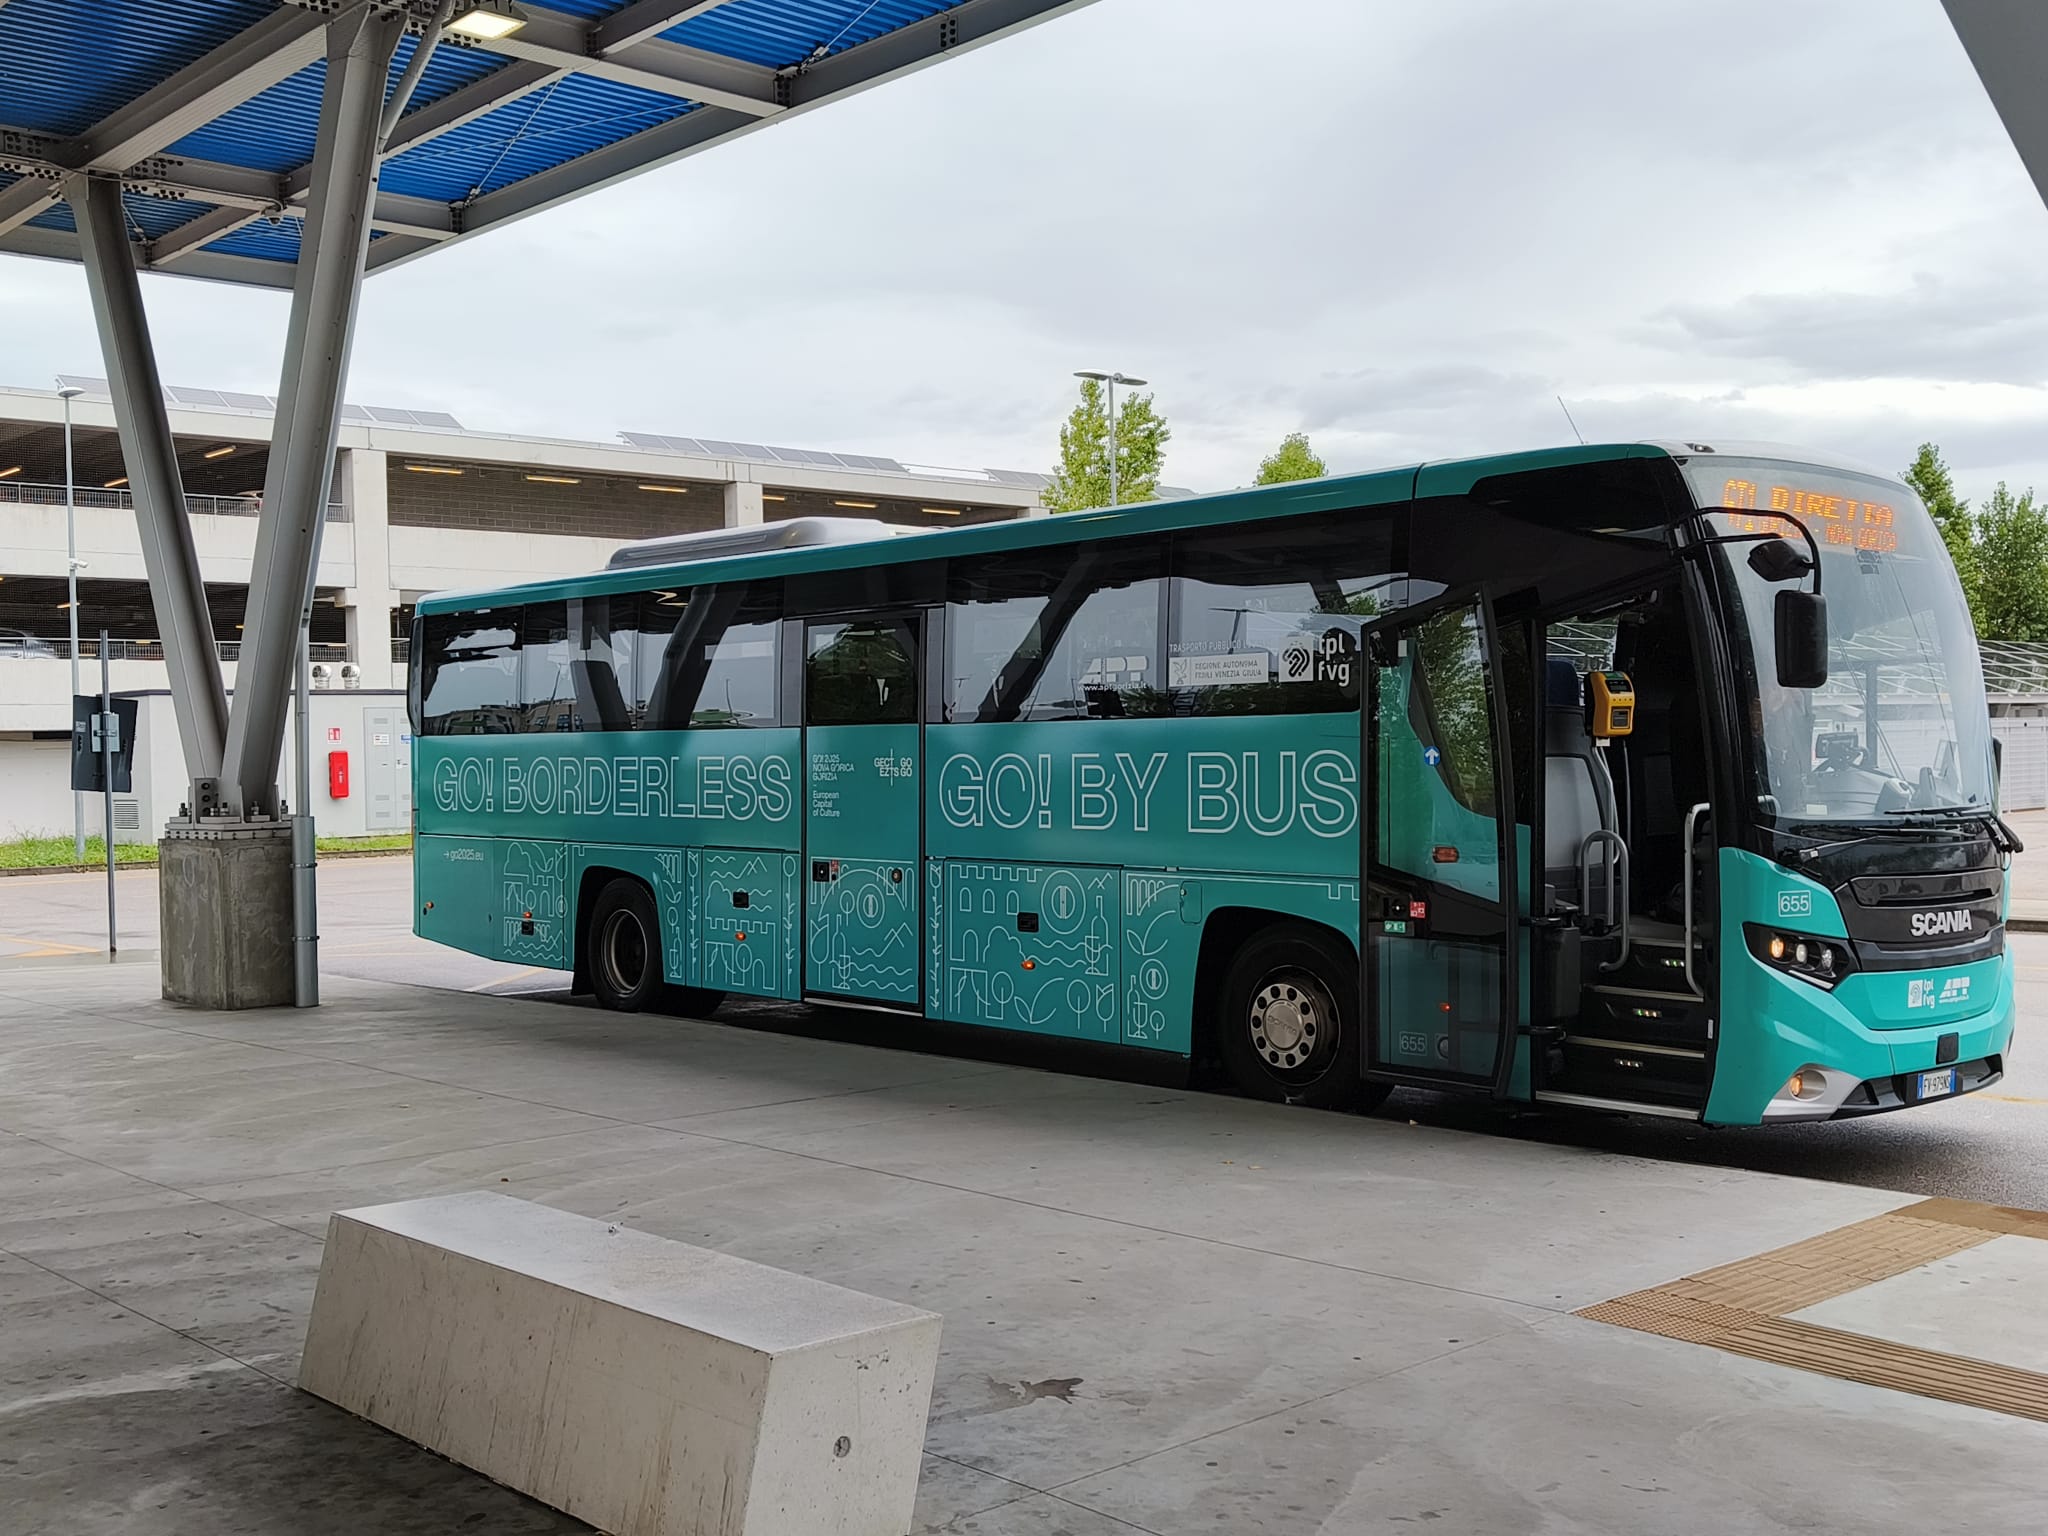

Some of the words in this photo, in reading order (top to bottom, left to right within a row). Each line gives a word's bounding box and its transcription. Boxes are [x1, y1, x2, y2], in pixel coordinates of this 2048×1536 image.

[1771, 486, 1893, 528] DIRETTA
[1318, 660, 1350, 687] fvg
[900, 757, 913, 767] GO
[900, 767, 913, 777] GO
[433, 756, 494, 813] GO!
[503, 754, 792, 822] BORDERLESS
[812, 790, 840, 800] European
[939, 753, 1052, 830] GO!
[1071, 752, 1168, 832] BY
[1187, 749, 1359, 838] BUS
[812, 799, 833, 808] Capital
[819, 808, 841, 817] Culture
[1780, 894, 1809, 912] 655
[1910, 909, 1973, 937] SCANIA
[1401, 1035, 1425, 1051] 655
